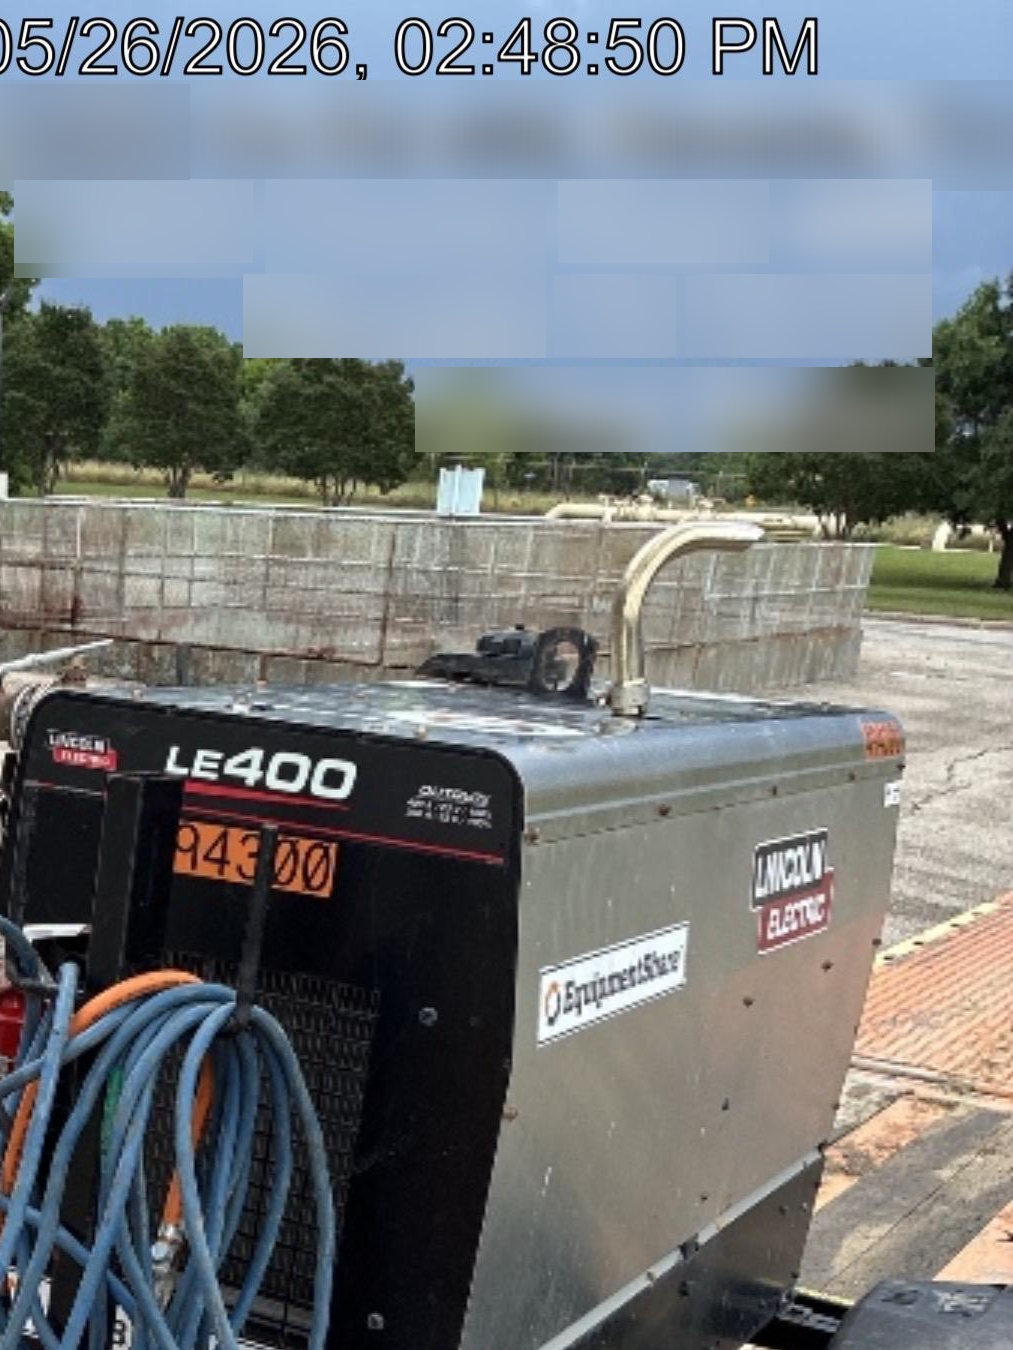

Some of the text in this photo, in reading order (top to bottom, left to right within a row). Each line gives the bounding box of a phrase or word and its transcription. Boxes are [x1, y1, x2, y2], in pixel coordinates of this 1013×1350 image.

[48, 733, 106, 754] LINCOLN
[164, 745, 358, 801] LE400
[754, 839, 825, 899] LINCOLN
[767, 893, 826, 941] ELECTRIC
[563, 949, 682, 1017] EquipmentShare
